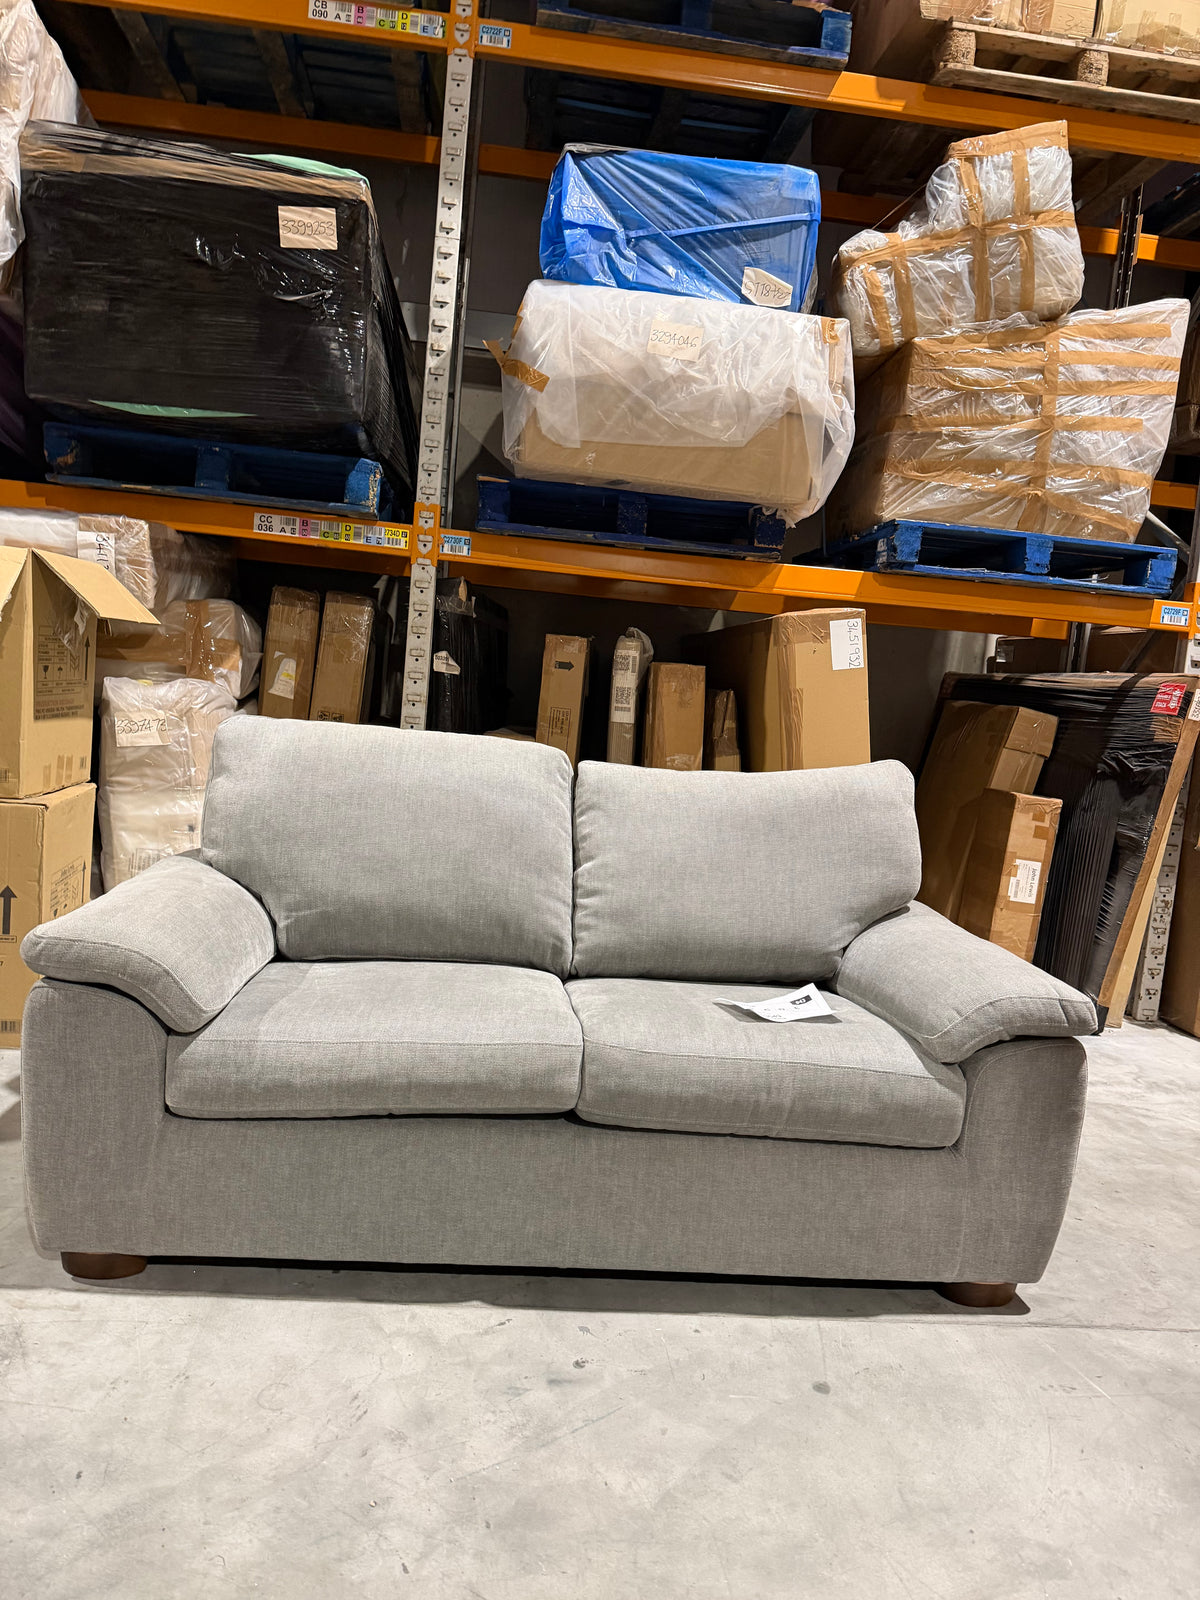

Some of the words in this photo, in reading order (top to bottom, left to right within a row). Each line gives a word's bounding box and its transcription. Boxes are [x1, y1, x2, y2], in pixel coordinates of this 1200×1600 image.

[313, 0, 328, 9] CB
[311, 9, 328, 19] 090
[357, 6, 364, 14] B
[334, 13, 341, 21] A
[401, 12, 408, 20] D
[378, 19, 385, 27] C
[422, 25, 428, 33] E
[281, 219, 335, 237] 3399253
[650, 329, 699, 348] 3294046
[259, 515, 273, 524] CC
[301, 519, 309, 527] B
[257, 523, 274, 532] 036
[279, 526, 287, 534] A
[345, 524, 352, 532] D
[322, 531, 330, 539] C
[365, 536, 372, 544] E
[846, 620, 861, 668] 3451932
